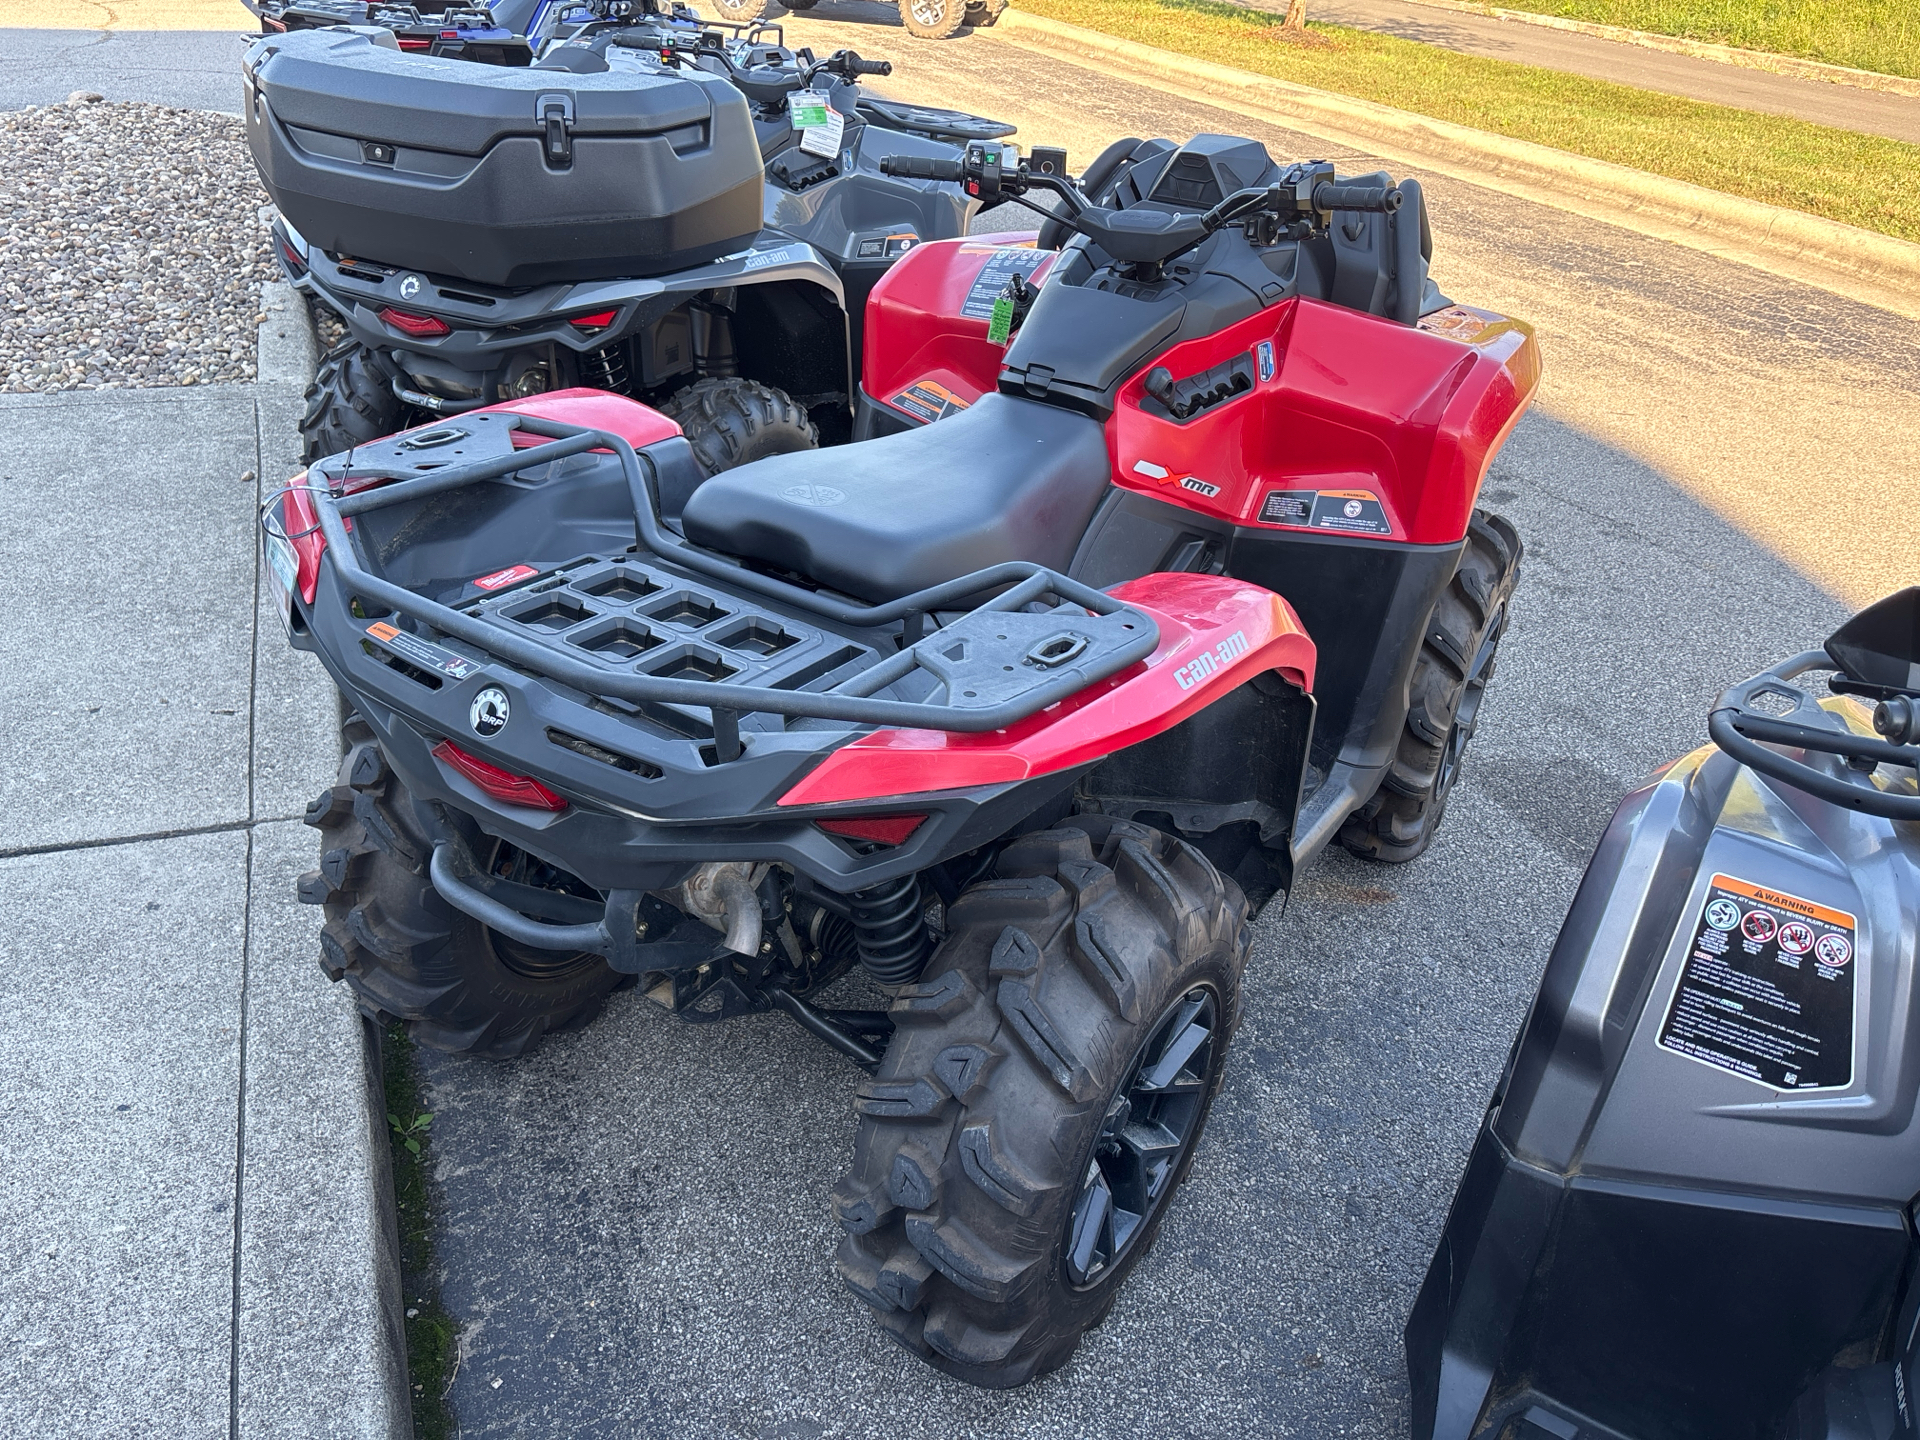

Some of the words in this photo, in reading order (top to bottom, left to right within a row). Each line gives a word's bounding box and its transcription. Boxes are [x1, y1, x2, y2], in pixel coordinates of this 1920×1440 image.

[745, 251, 790, 268] can-am
[1173, 630, 1249, 690] can-am
[481, 713, 503, 726] BRP
[1717, 890, 1738, 900] Improper
[1786, 911, 1806, 921] SEVERE
[1806, 917, 1824, 927] INJURY
[1830, 925, 1847, 934] DEATH
[1765, 893, 1814, 914] WARNING
[1694, 951, 1712, 960] NEVER
[1895, 1361, 1907, 1415] ROTAX
